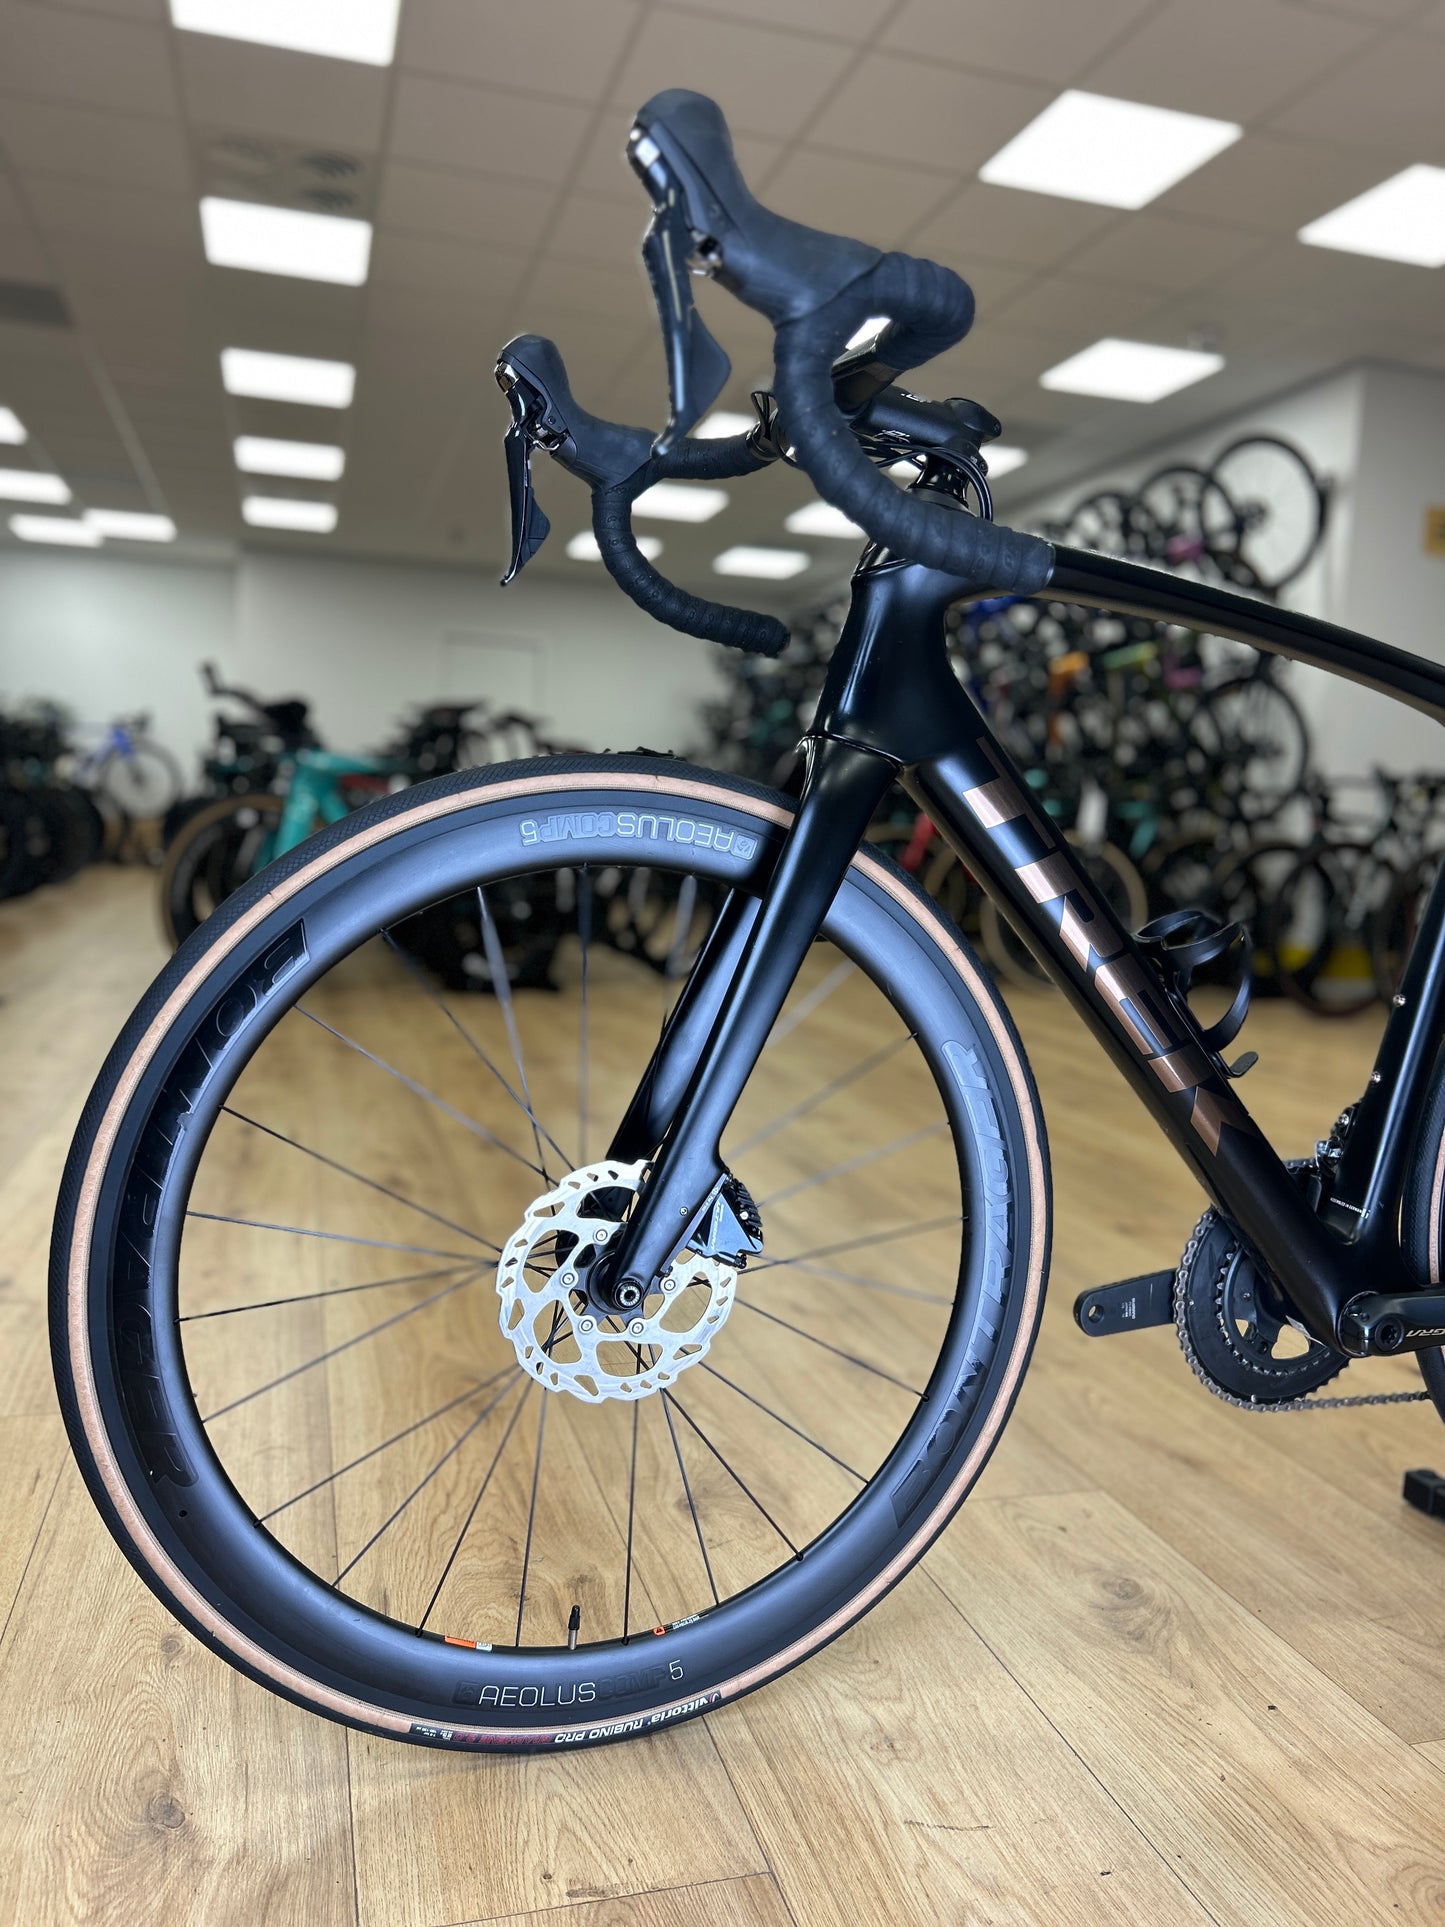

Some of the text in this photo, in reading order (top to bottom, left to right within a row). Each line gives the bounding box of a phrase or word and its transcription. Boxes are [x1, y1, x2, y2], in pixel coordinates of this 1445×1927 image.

[520, 820, 538, 846] 5
[616, 814, 735, 851] AEOLUS
[963, 736, 1259, 1156] TREK
[889, 1037, 1013, 1529] BONTRAGER
[478, 1682, 596, 1707] AEOLUS
[668, 1659, 684, 1681] 5
[651, 1697, 708, 1723] vittoria
[554, 1731, 586, 1743] PRO
[588, 1719, 643, 1739] RUBINO
